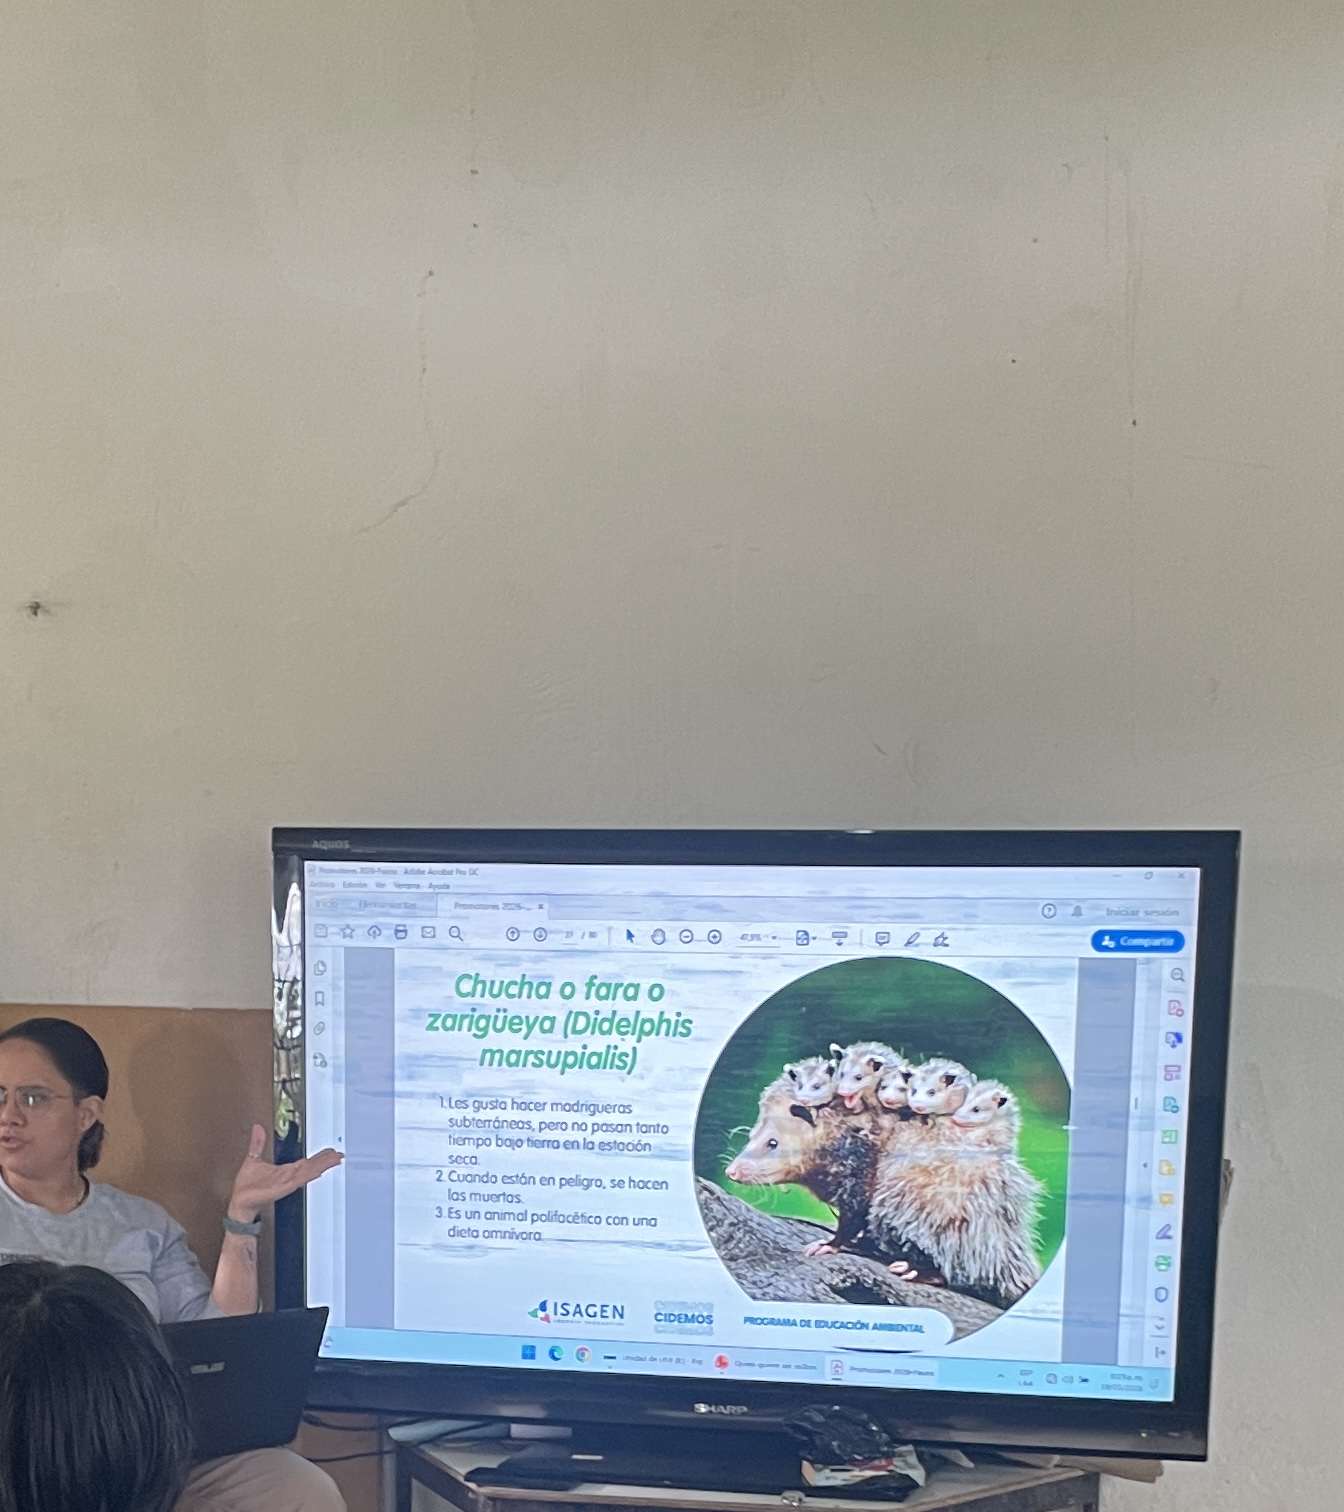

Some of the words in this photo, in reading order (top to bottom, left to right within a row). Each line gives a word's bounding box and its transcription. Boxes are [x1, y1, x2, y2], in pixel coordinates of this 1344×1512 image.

[1106, 907, 1140, 917] Iniciar
[1143, 907, 1179, 917] sesión
[1119, 935, 1175, 948] Compartir
[455, 973, 552, 1000] Chucha
[559, 981, 576, 1000] o
[585, 974, 640, 1001] fara
[648, 982, 665, 1002] o
[425, 1007, 556, 1040] zarigüeya
[563, 1009, 694, 1043] (Didelphis
[479, 1044, 638, 1075] marsupialis)
[449, 1096, 469, 1110] Les
[472, 1098, 507, 1113] gusta
[511, 1097, 547, 1112] hacer
[551, 1099, 633, 1115] madrigueras
[448, 1115, 536, 1132] subterráneas,
[538, 1120, 568, 1134] pero
[571, 1121, 588, 1132] no
[591, 1122, 633, 1135] pasan
[635, 1121, 669, 1135] tanto
[448, 1134, 492, 1149] tiempo
[495, 1134, 524, 1150] bajo
[527, 1137, 560, 1150] tierra
[562, 1139, 580, 1150] en
[582, 1137, 595, 1151] la
[598, 1138, 652, 1152] estación
[448, 1170, 498, 1184] Cuando
[501, 1172, 536, 1187] están
[539, 1176, 556, 1187] en
[558, 1174, 606, 1191] peligro,
[610, 1178, 625, 1189] se
[628, 1176, 669, 1191] hacen
[447, 1188, 466, 1202] las
[447, 1207, 461, 1220] Es
[464, 1209, 481, 1220] un
[484, 1209, 528, 1223] animal
[530, 1210, 602, 1225] polifacético
[605, 1214, 629, 1226] con
[632, 1216, 658, 1228] una
[447, 1225, 479, 1239] dieta
[553, 1301, 625, 1320] ISAGEN
[654, 1312, 714, 1325] CIDEMOS
[743, 1316, 798, 1328] PROGRAMA
[799, 1319, 813, 1328] DE
[814, 1319, 869, 1331] EDUCACIÓN
[871, 1322, 926, 1334] AMBIENTAL
[693, 1402, 749, 1416] SHARP
